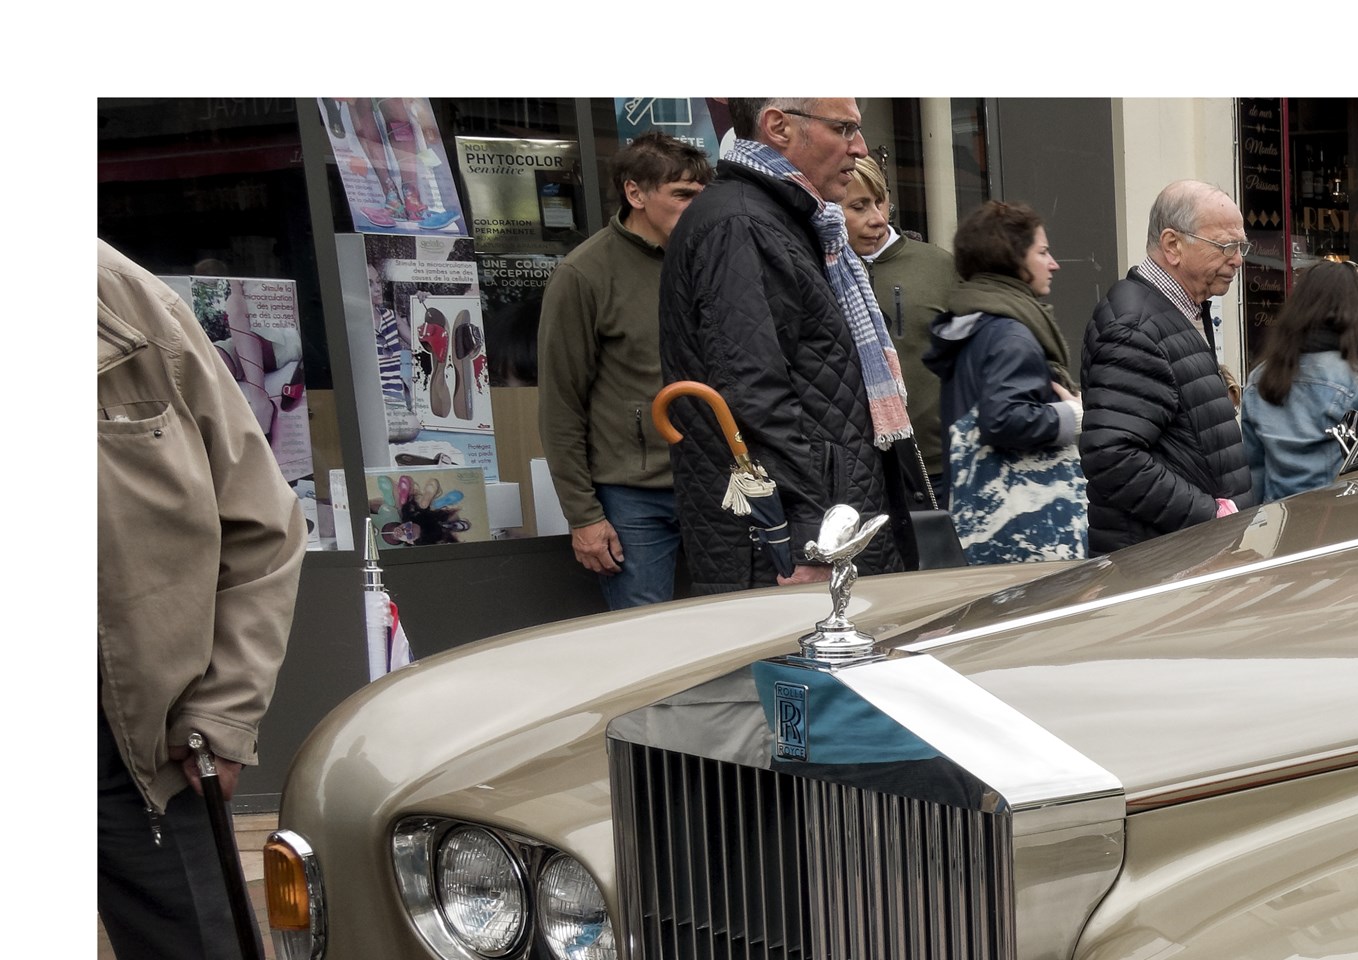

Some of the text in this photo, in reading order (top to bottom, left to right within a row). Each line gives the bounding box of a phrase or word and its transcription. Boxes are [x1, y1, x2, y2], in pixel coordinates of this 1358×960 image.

[466, 153, 563, 168] PHYTOCOLOR
[467, 165, 525, 175] Sensitive
[1246, 174, 1280, 192] Poissons
[483, 260, 507, 268] UNE
[484, 279, 498, 287] LA
[1249, 275, 1281, 292] Salades
[777, 686, 803, 699] ROLLS
[779, 745, 804, 758] ROYCE
